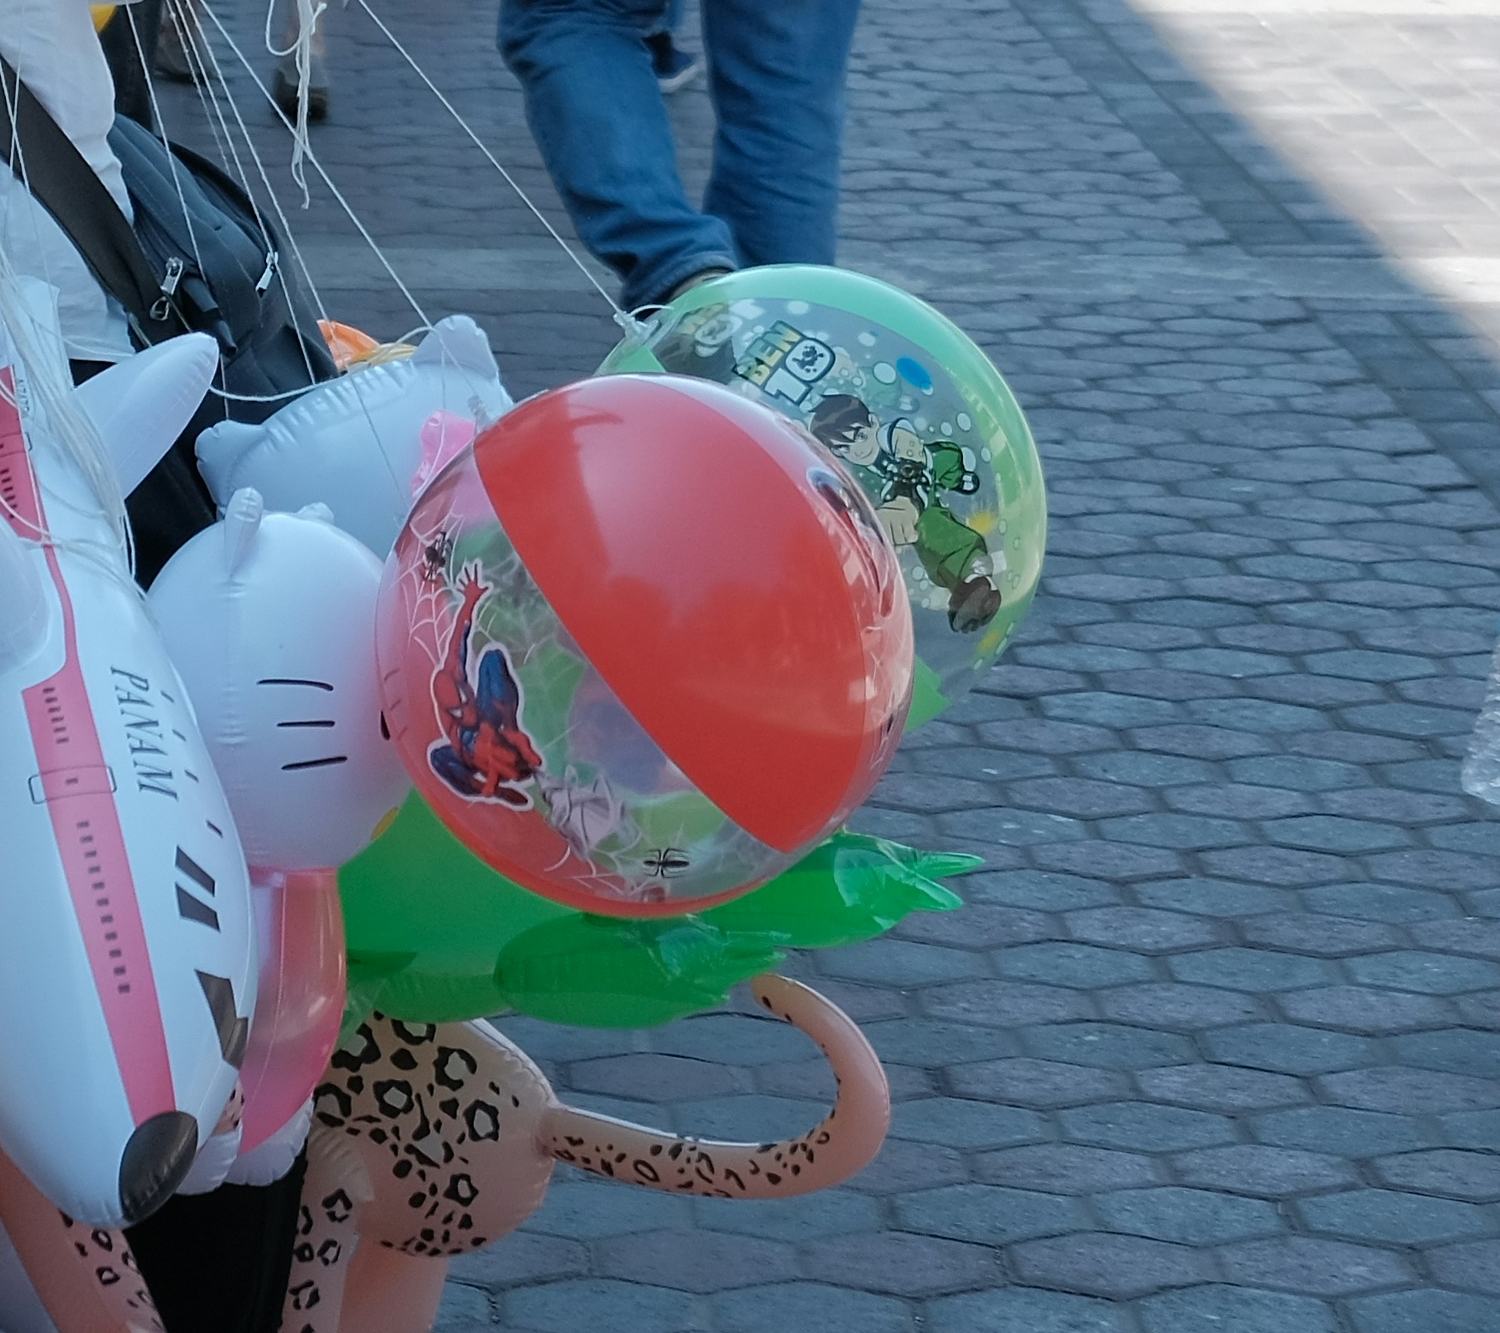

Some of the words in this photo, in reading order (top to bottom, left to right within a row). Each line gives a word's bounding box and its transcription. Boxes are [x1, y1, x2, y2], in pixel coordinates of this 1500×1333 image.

[731, 319, 801, 386] BEN
[762, 336, 836, 406] 10
[110, 665, 179, 803] PANAM
